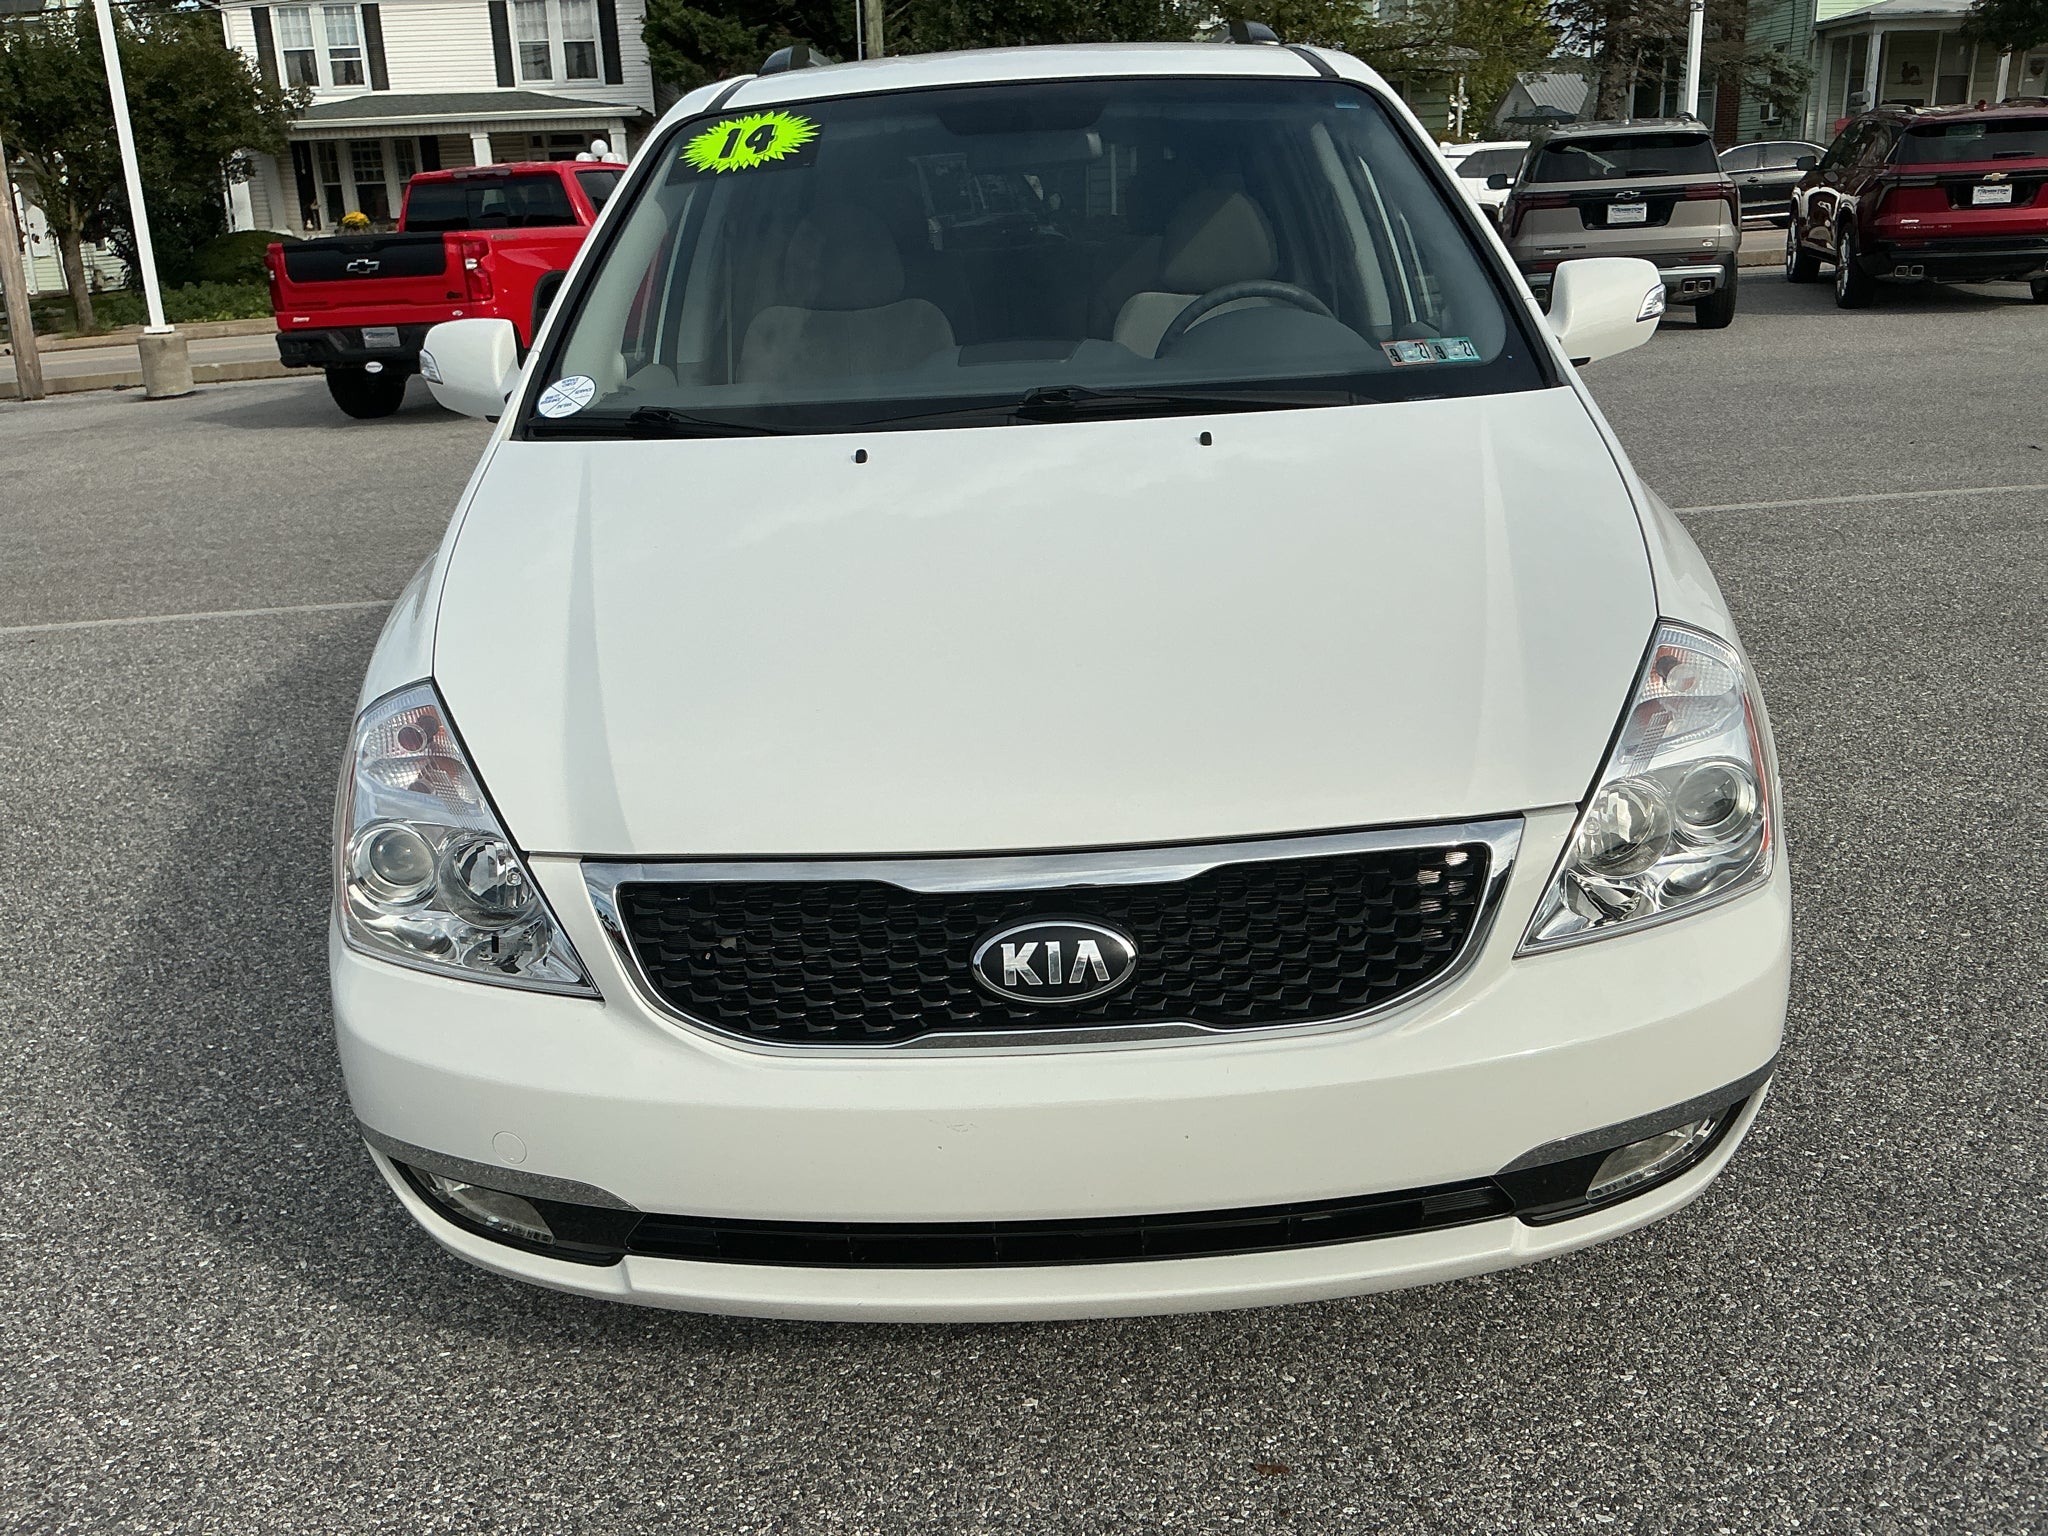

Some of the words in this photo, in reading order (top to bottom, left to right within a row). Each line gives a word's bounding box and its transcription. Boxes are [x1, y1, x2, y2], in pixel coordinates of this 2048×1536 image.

[718, 124, 778, 159] 14
[1389, 348, 1402, 362] 9
[1414, 342, 1430, 359] 27
[1434, 345, 1446, 360] 9
[1459, 340, 1475, 357] 27
[1001, 940, 1110, 986] KIA
